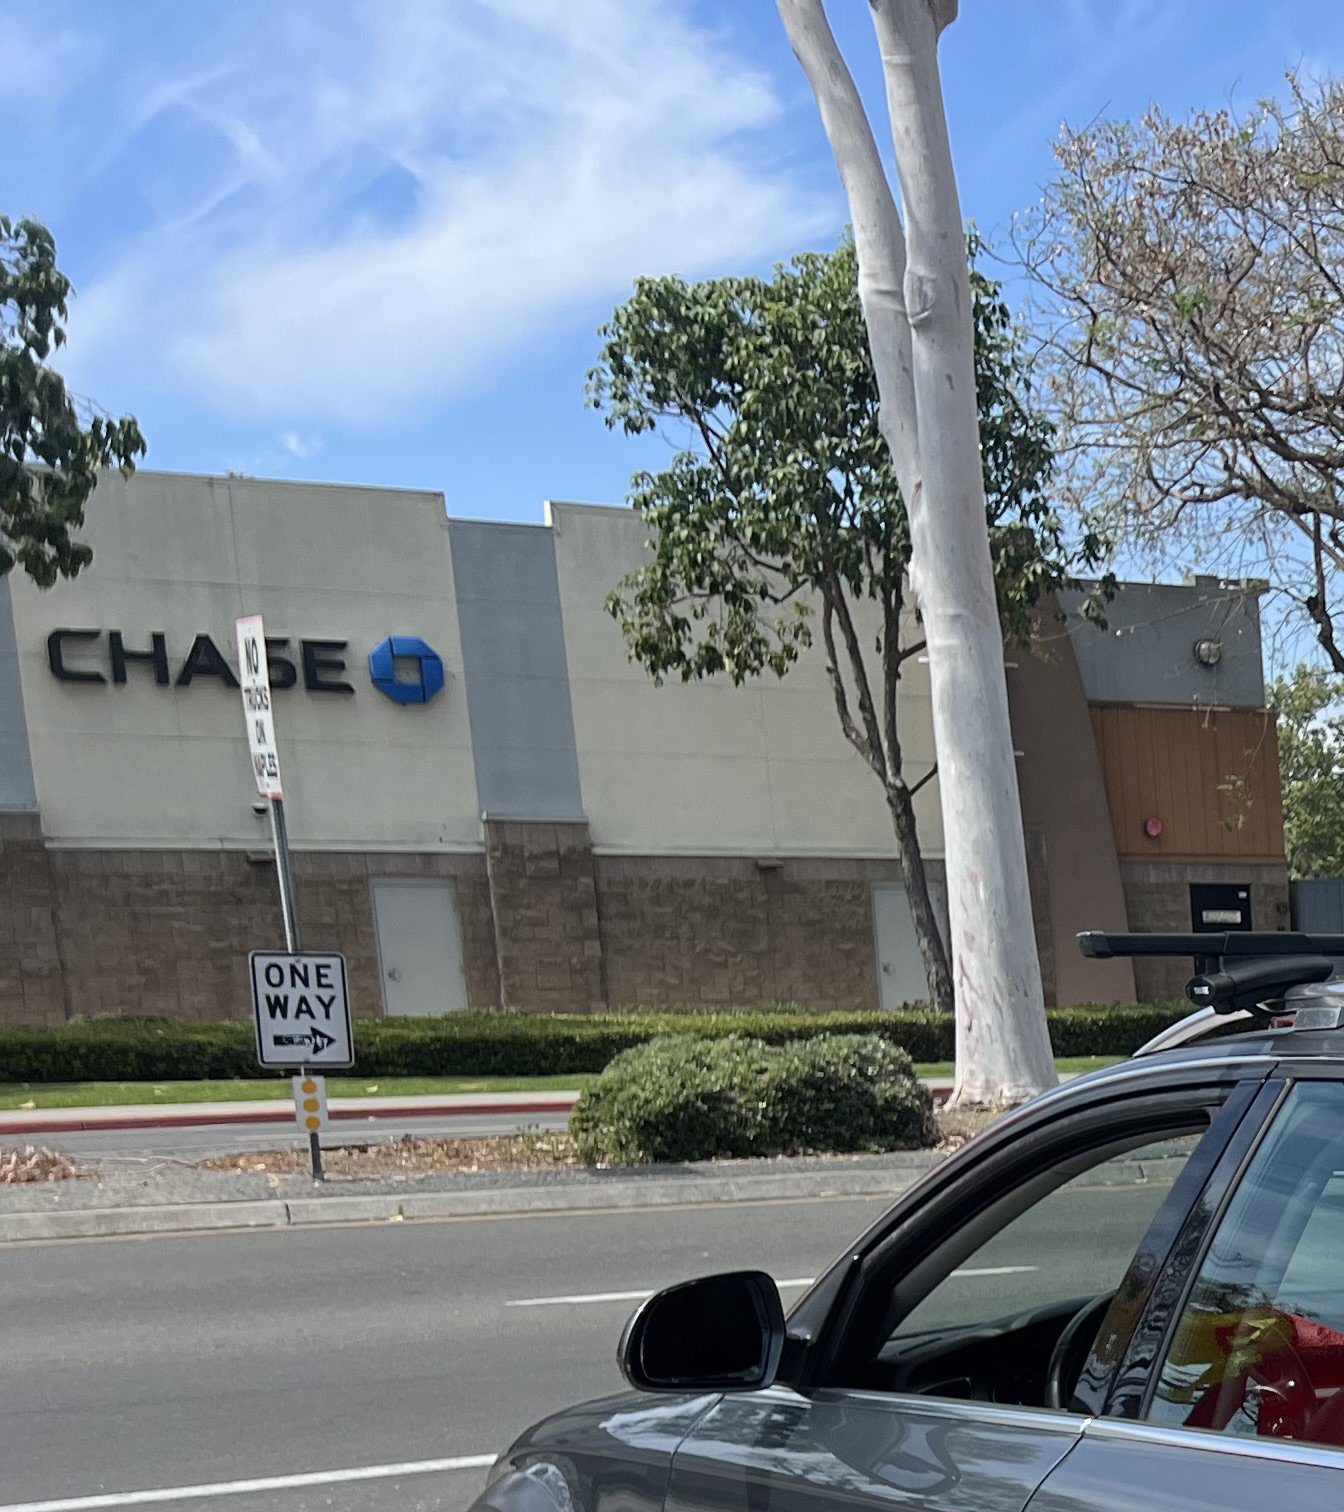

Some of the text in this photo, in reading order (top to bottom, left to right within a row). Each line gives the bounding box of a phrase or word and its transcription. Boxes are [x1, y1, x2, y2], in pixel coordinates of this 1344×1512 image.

[47, 626, 355, 694] CHASE
[243, 636, 259, 677] NO
[265, 963, 334, 988] ONE
[265, 993, 336, 1020] WAY
